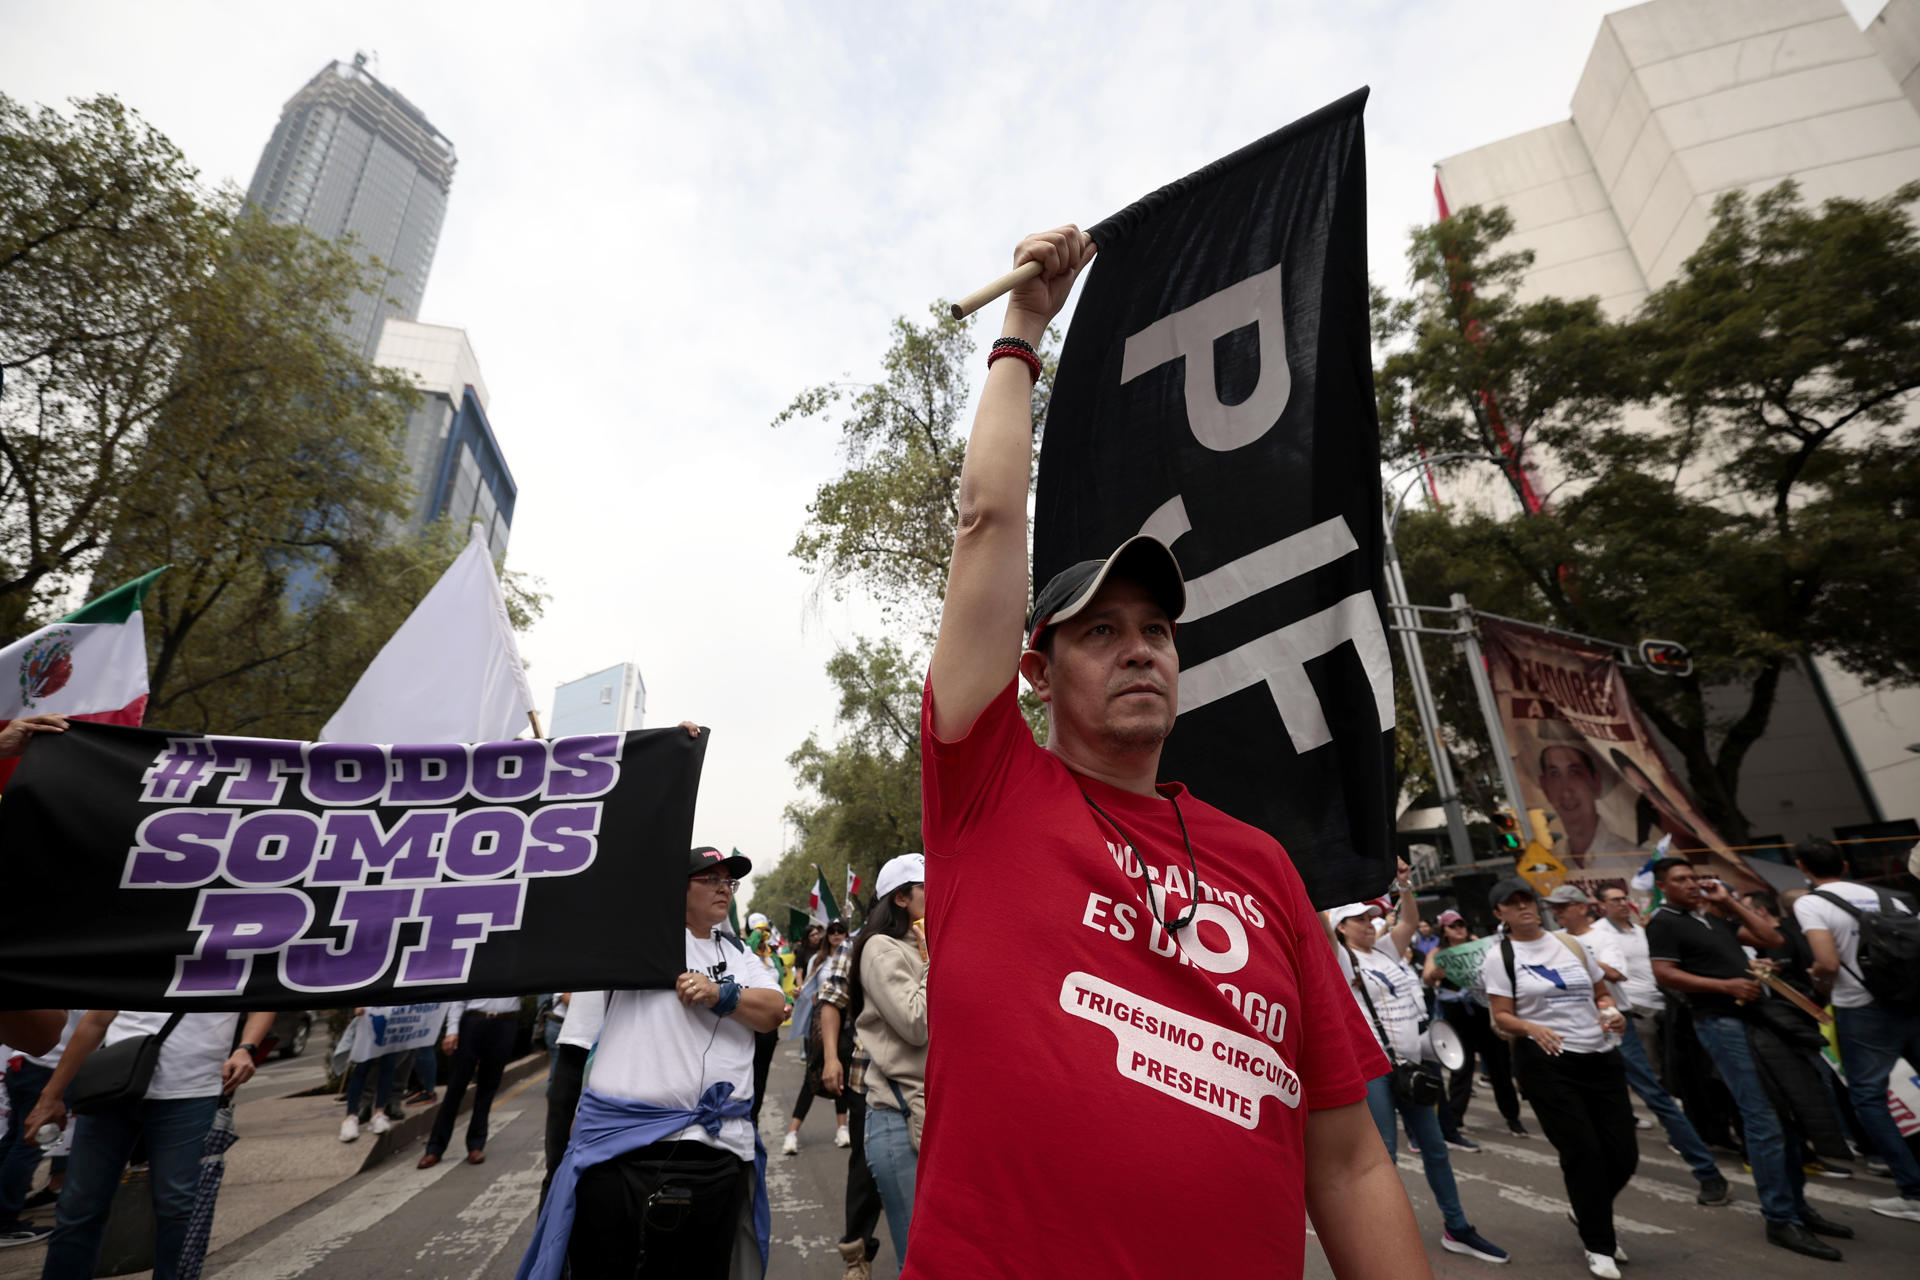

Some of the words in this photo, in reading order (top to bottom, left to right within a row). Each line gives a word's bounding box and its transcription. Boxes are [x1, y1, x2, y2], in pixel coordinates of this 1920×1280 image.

[139, 732, 626, 805] #TODOS
[119, 801, 604, 889] SOMOS
[165, 878, 529, 998] PJF
[1082, 892, 1137, 941] ES
[1075, 986, 1204, 1051] TRIGÉSIMO
[1212, 1041, 1299, 1096] CIRCUITO
[1131, 1051, 1252, 1120] PRESENTE
